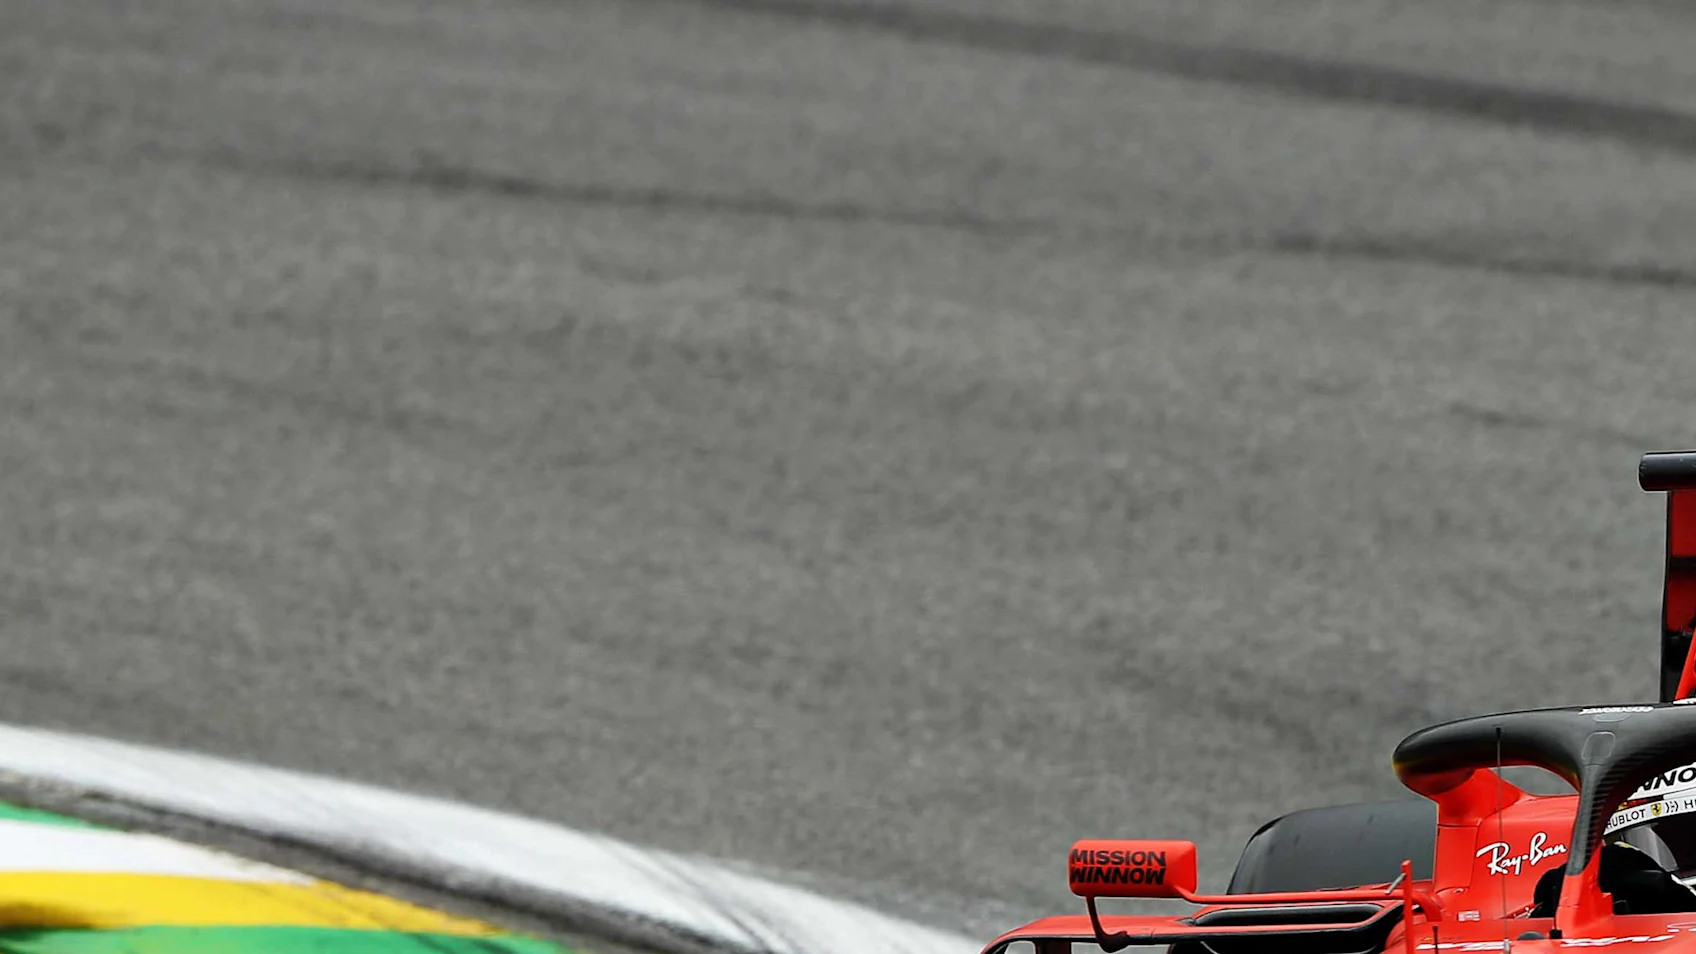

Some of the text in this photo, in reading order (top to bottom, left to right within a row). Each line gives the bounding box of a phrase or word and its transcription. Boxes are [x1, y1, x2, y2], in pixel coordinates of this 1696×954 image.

[1072, 850, 1166, 867] MISSION
[1476, 832, 1567, 875] Ray-Ban
[1069, 866, 1165, 885] WINNOW
